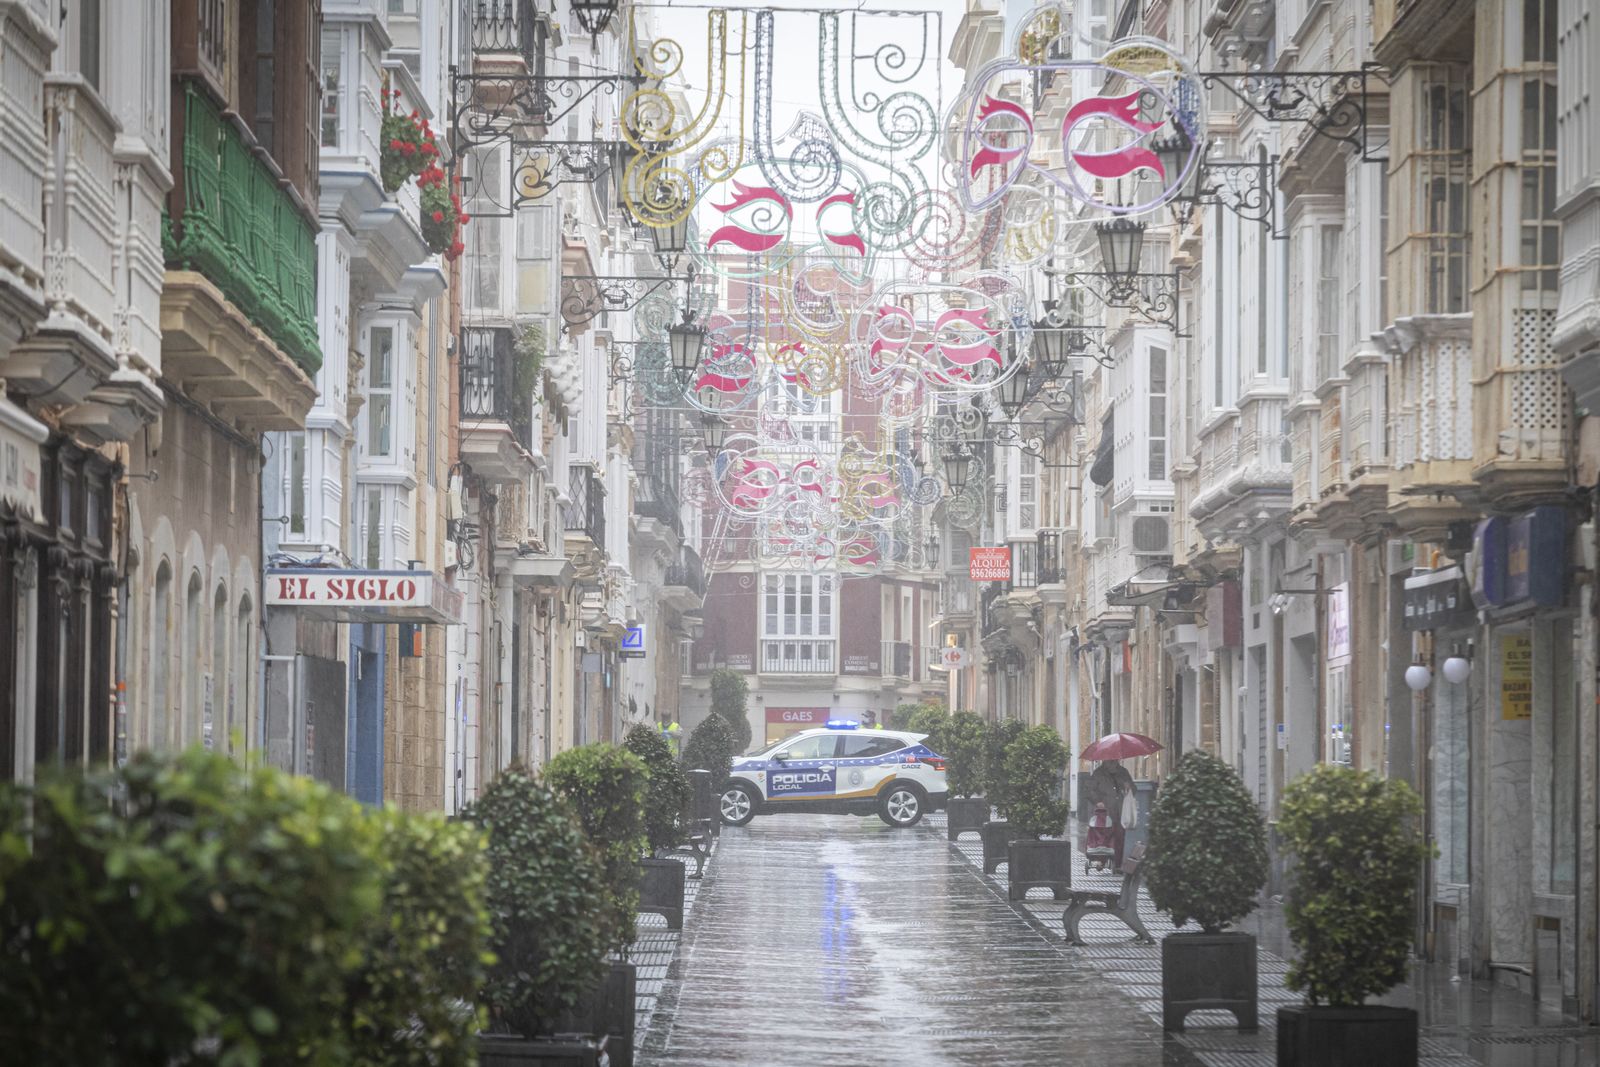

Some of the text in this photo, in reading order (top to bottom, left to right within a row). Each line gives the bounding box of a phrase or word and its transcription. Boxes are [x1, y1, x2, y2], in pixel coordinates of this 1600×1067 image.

[971, 559, 1010, 568] ALQUILA
[278, 578, 416, 600] EL SIGLO
[782, 711, 813, 721] GAES
[772, 773, 832, 784] POLICIA
